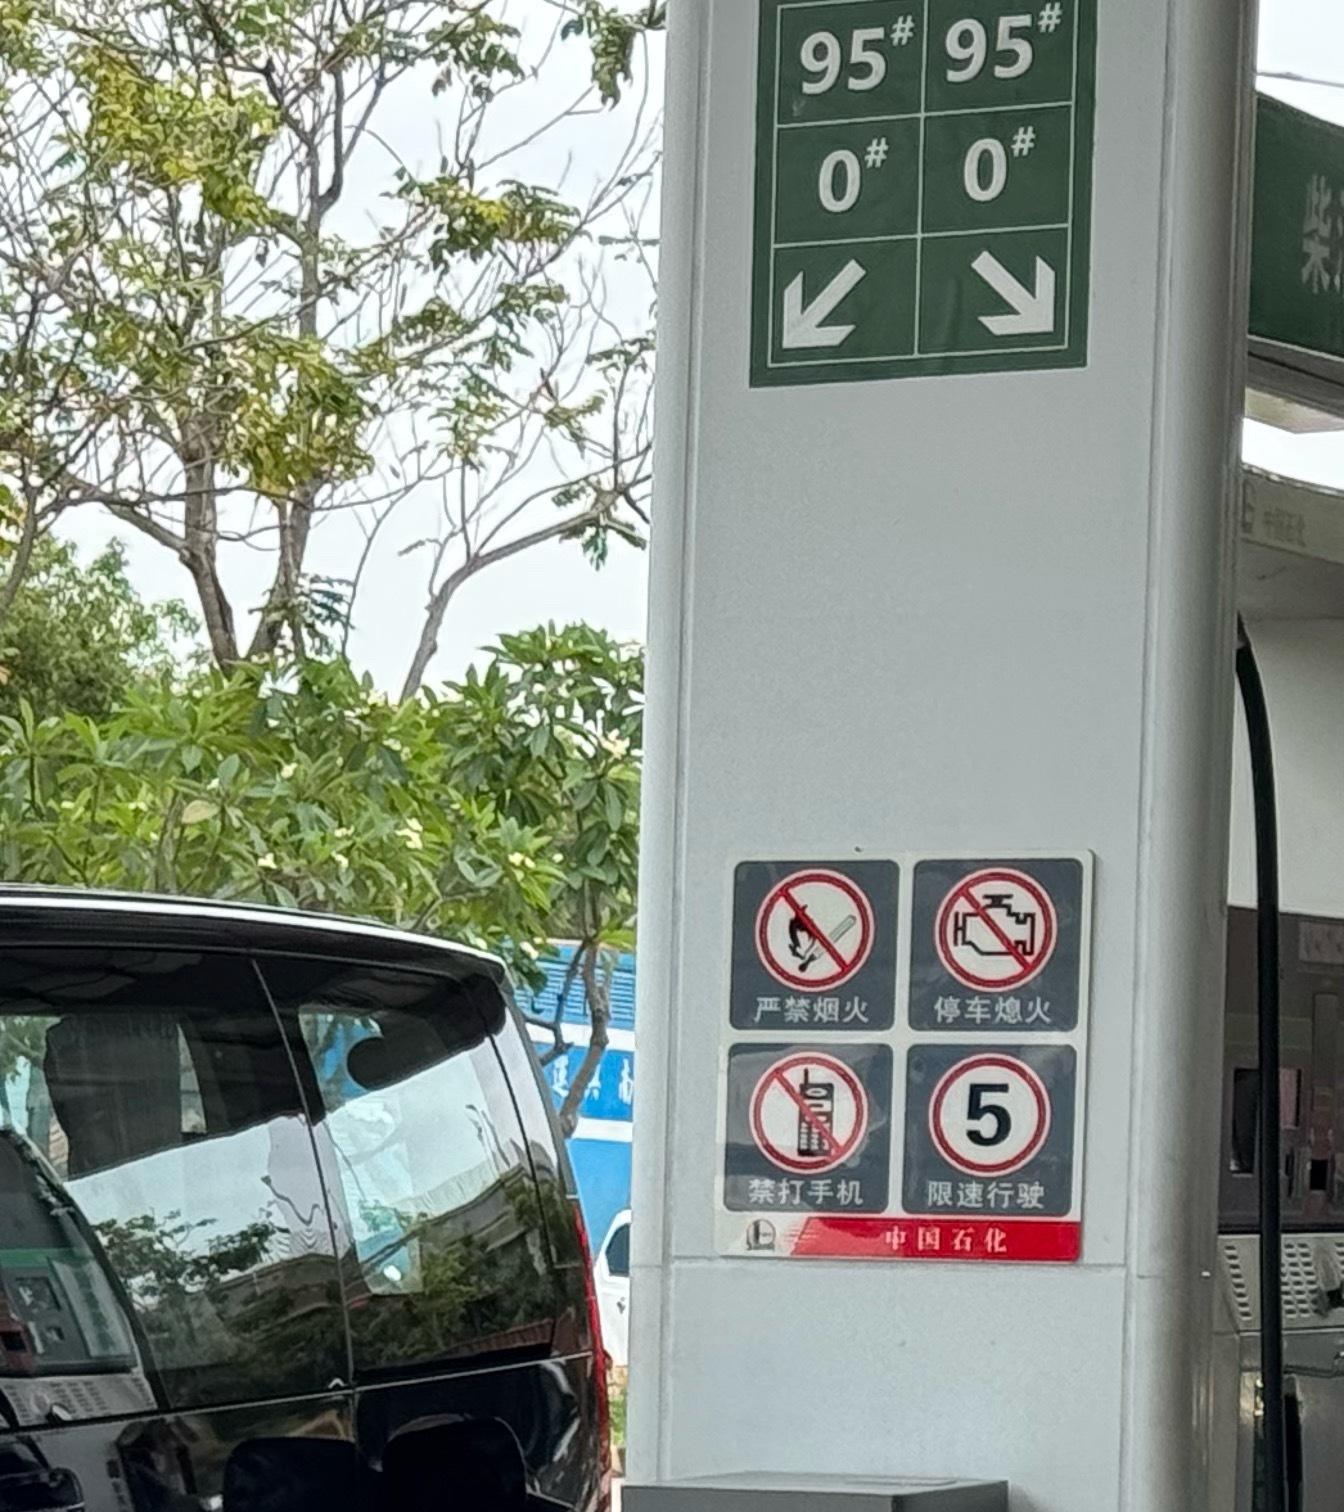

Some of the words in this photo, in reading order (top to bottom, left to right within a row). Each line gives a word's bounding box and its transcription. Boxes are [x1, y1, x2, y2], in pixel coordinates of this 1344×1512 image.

[753, 996, 869, 1024] 严禁烟火
[934, 996, 1052, 1025] 停车熄火
[965, 1083, 1012, 1147] 5
[748, 1179, 864, 1206] 禁打手机
[927, 1180, 1045, 1209] 限速行驶
[884, 1226, 1008, 1253] 中国石化
